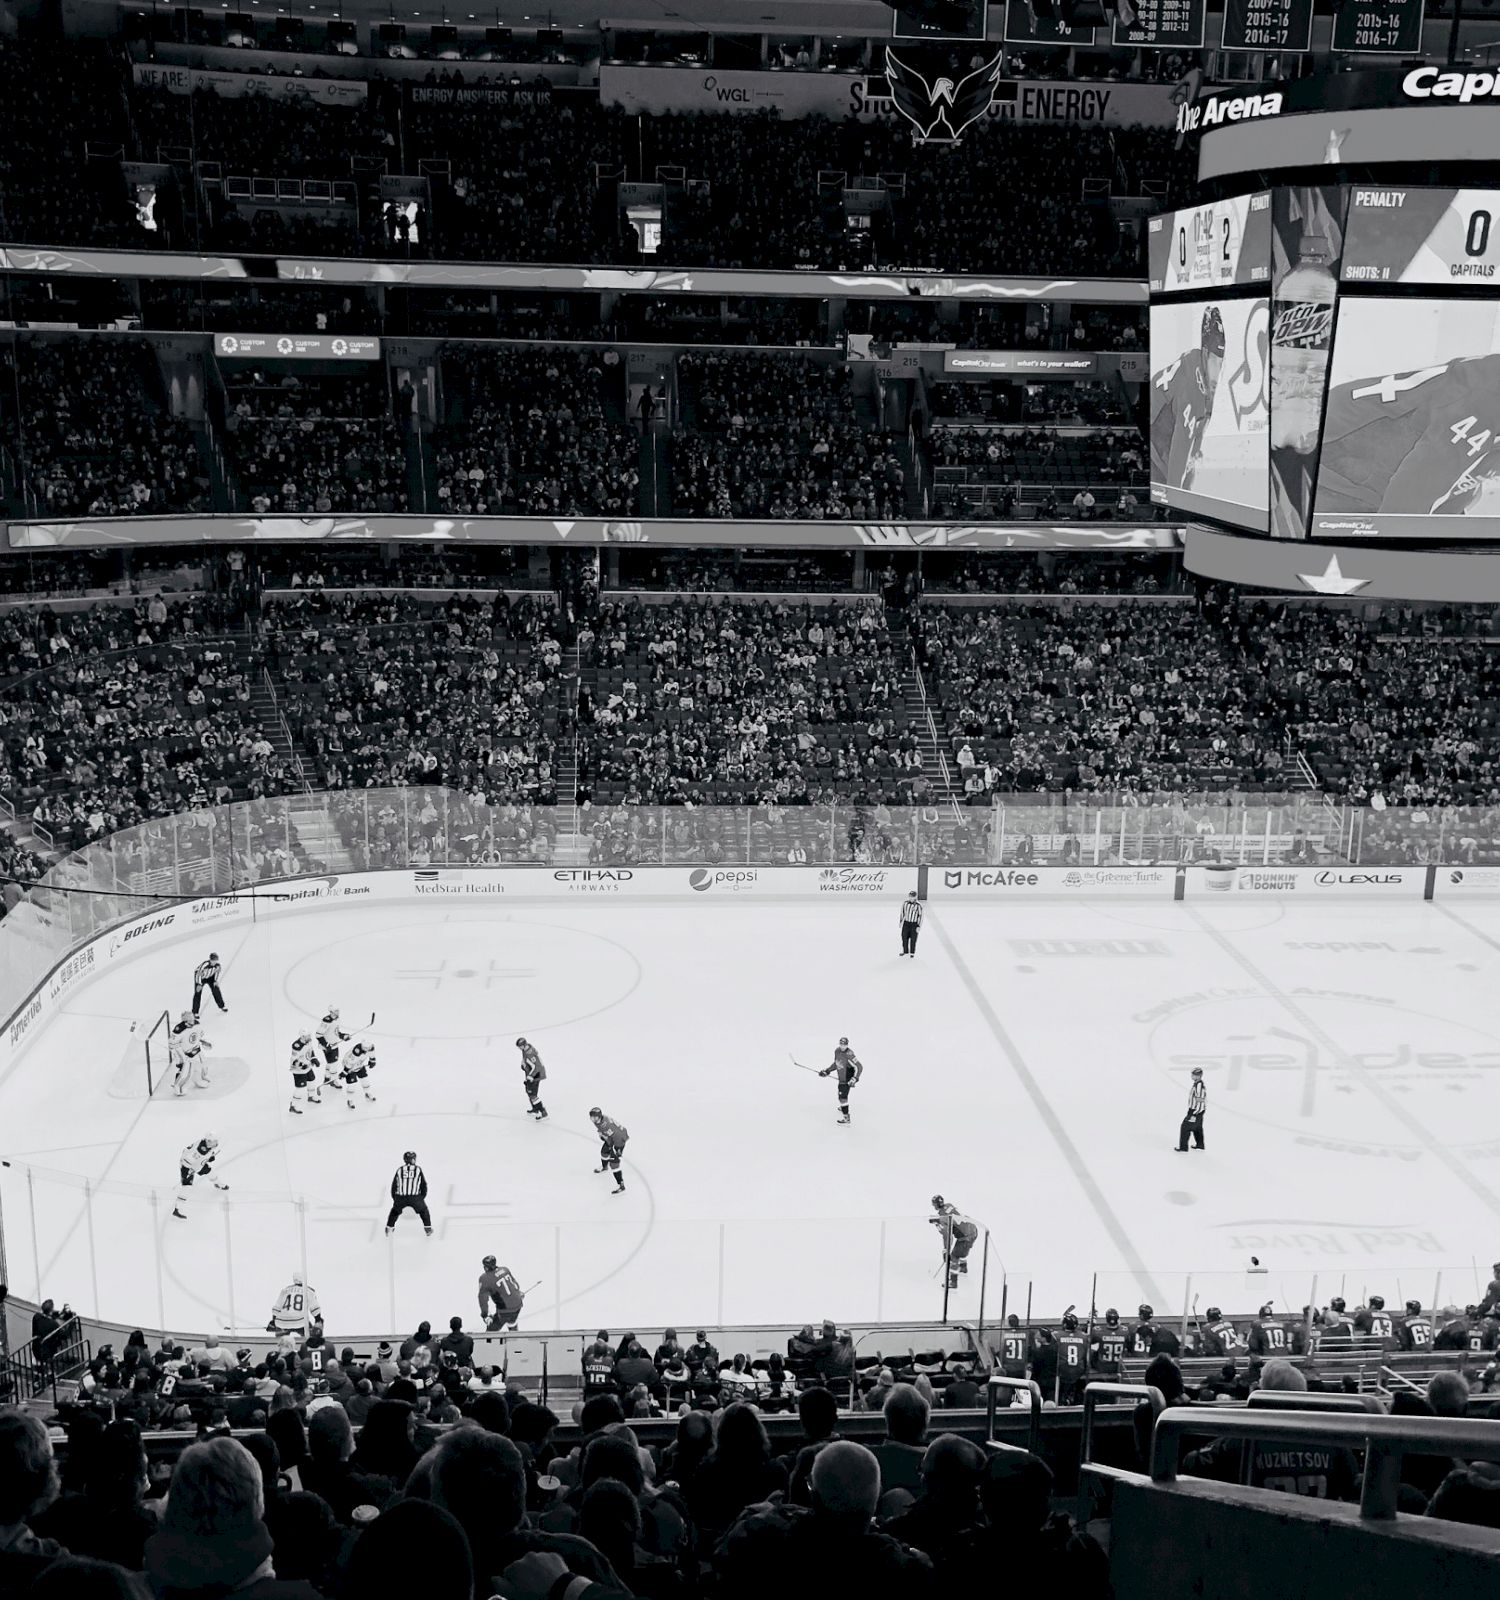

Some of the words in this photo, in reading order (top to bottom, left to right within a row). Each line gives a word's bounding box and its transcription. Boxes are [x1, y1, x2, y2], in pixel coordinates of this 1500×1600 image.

[1162, 21, 1189, 31] 2012-13
[1246, 12, 1289, 27] 2015-16
[1357, 13, 1400, 28] 2015-16
[1244, 30, 1288, 45] 2016-17
[1355, 31, 1399, 46] 2016-17
[140, 69, 158, 86] WE
[412, 88, 452, 103] ENERGY
[513, 91, 534, 105] ASK
[536, 91, 551, 105] US
[716, 89, 750, 102] WGL
[1022, 88, 1111, 121] ENERGY
[1201, 93, 1283, 126] Arena
[1355, 191, 1406, 207] PENALTY
[1223, 217, 1230, 260] 2
[1465, 210, 1491, 257] 0
[1179, 227, 1186, 267] 0
[1345, 266, 1381, 279] SHOTS:
[1450, 264, 1495, 276] CAPITALS
[903, 357, 918, 366] 215
[1121, 361, 1136, 369] 215
[876, 369, 892, 377] 216
[1450, 416, 1491, 457] 44
[553, 870, 633, 881] ETIHAD
[715, 870, 758, 884] pepsi
[839, 869, 887, 883] Sports
[967, 871, 1039, 886] McAfee
[1095, 871, 1132, 884] Greene
[1133, 871, 1162, 881] Turtle
[1254, 873, 1298, 881] DUNKIN'
[1338, 874, 1402, 884] LEXUS
[343, 886, 370, 896] Bank
[414, 884, 462, 894] MedStar
[465, 883, 504, 894] Health
[1254, 882, 1295, 890] DONUTS
[123, 914, 175, 941] BOEING
[1228, 1230, 1345, 1254] River
[1350, 1230, 1448, 1254] Red
[496, 1274, 519, 1296] 77
[282, 1294, 304, 1311] 48
[1371, 1319, 1392, 1337] 43
[1266, 1329, 1284, 1348] 10
[1006, 1339, 1023, 1360] 31
[1067, 1345, 1078, 1366] 8
[1103, 1343, 1123, 1361] 39
[311, 1351, 322, 1371] 8
[161, 1376, 177, 1396] 8
[1256, 1451, 1330, 1470] KUZNETSOV
